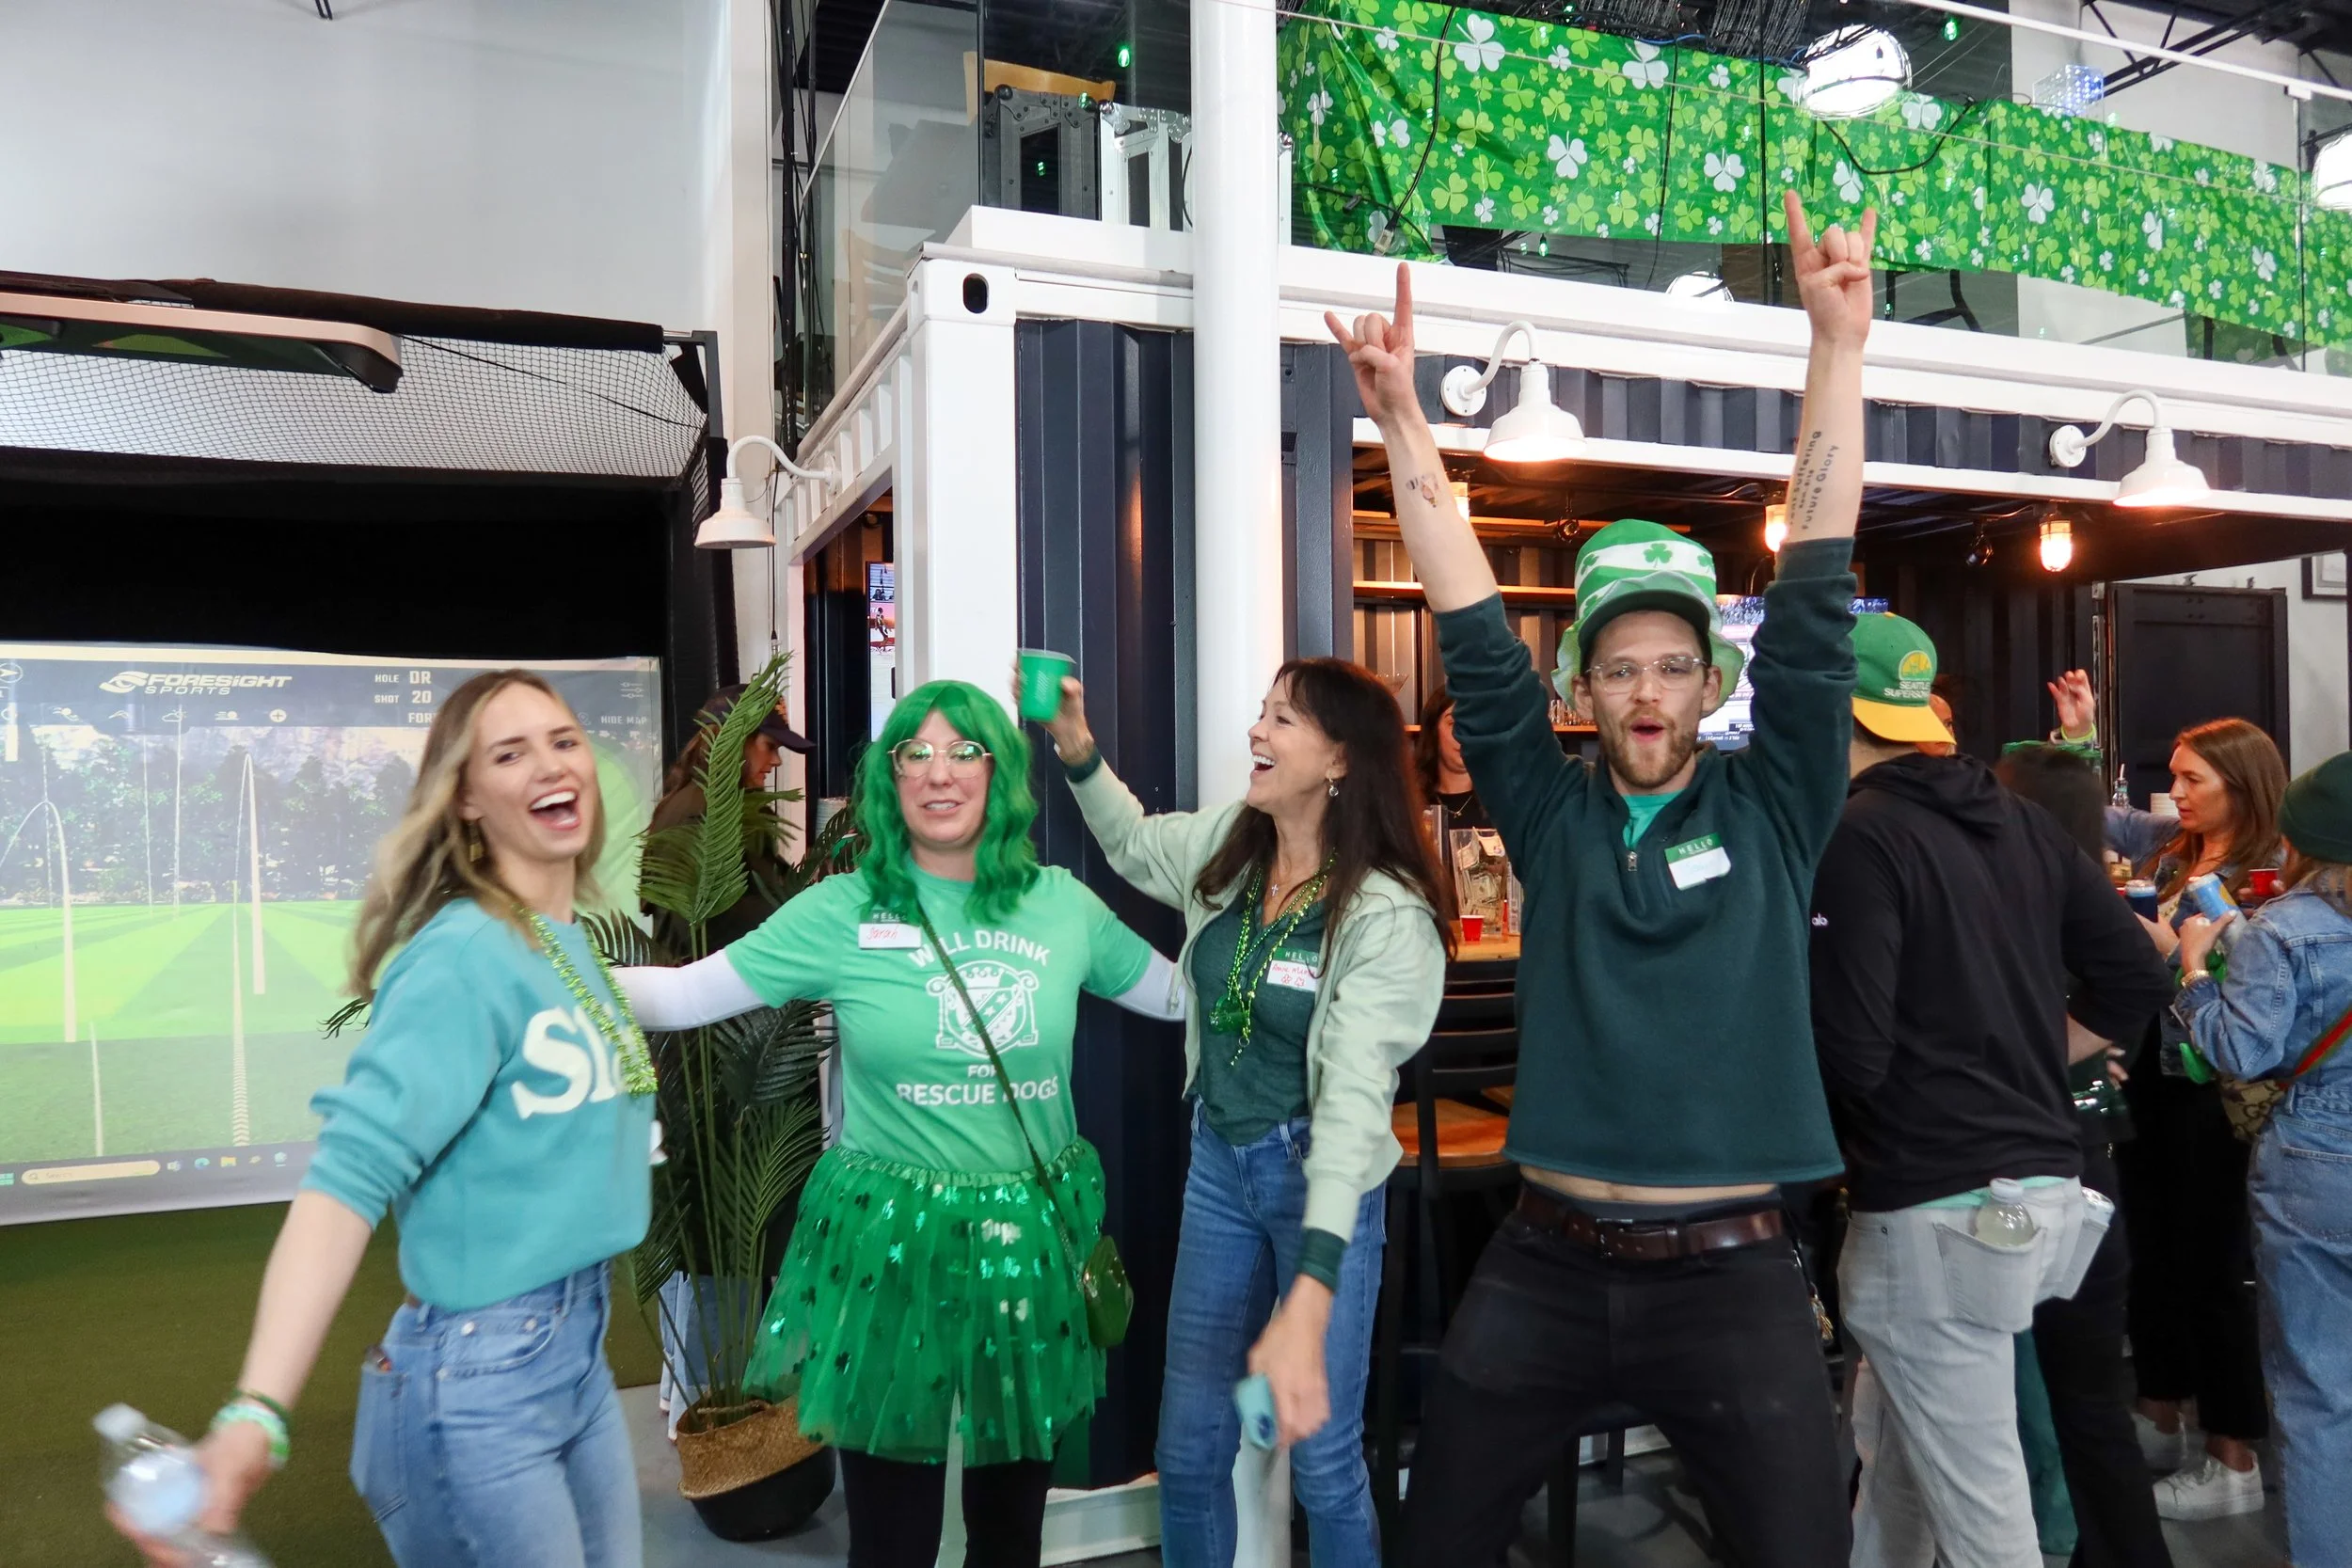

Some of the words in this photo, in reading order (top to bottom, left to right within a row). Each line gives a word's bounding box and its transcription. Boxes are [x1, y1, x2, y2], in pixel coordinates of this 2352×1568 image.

[1802, 486, 1822, 530] Future
[1816, 444, 1840, 483] Glory
[374, 673, 400, 684] HOLE
[409, 671, 432, 685] DR
[144, 686, 231, 696] SPORTS
[374, 694, 399, 704] SHOT
[411, 690, 432, 705] 20
[600, 715, 623, 725] HIDE
[626, 715, 647, 725] MAP
[1677, 837, 1713, 856] HELLO
[907, 931, 972, 968] WLL
[975, 929, 1052, 967] DRINK
[896, 1083, 995, 1105] RESCUE
